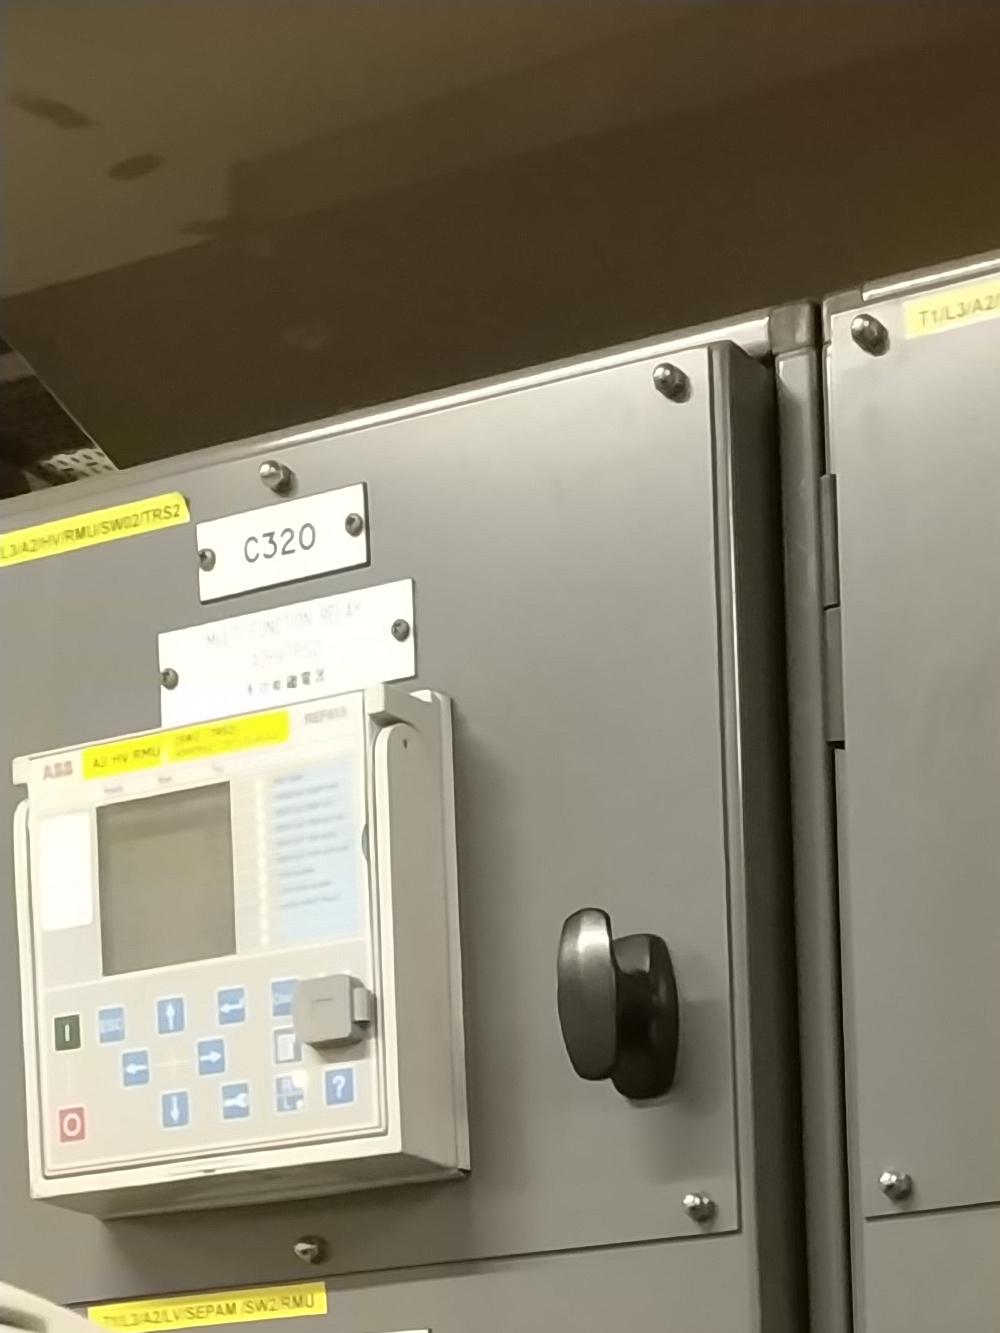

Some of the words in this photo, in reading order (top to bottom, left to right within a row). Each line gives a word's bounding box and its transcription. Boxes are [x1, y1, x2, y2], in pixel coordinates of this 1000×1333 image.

[243, 523, 316, 563] C320
[133, 745, 161, 763] RMU
[43, 760, 74, 780] ABB
